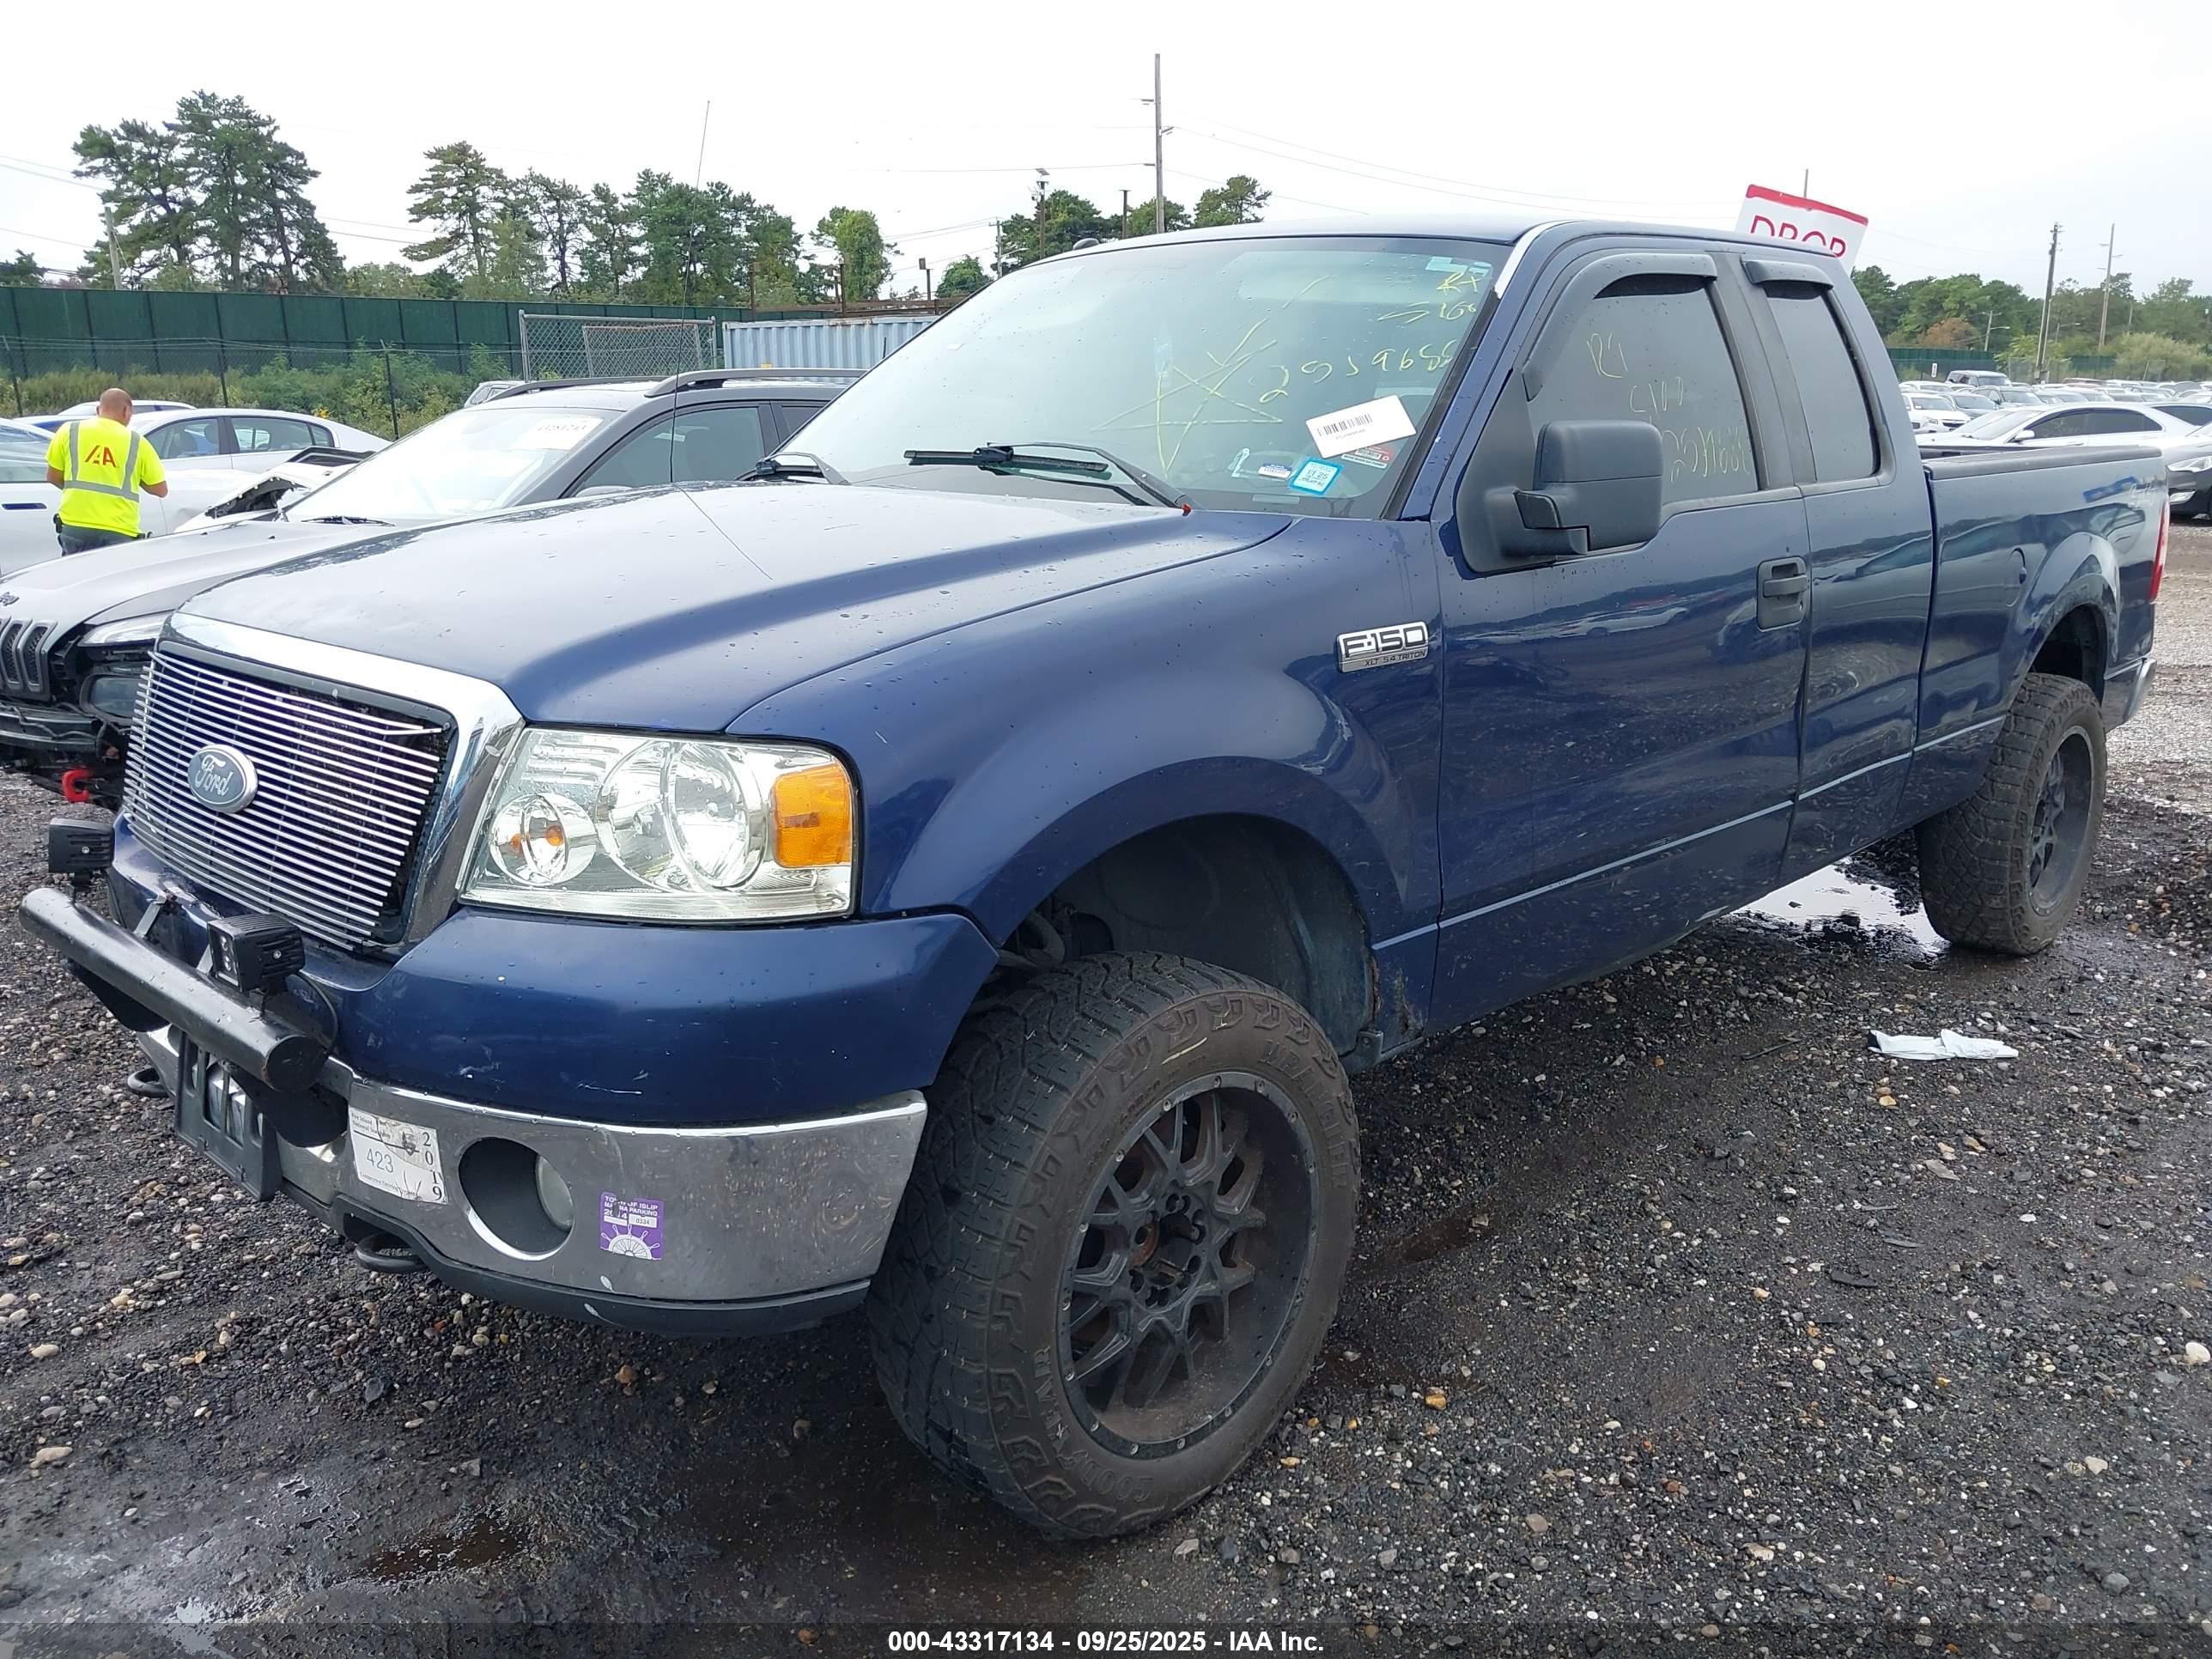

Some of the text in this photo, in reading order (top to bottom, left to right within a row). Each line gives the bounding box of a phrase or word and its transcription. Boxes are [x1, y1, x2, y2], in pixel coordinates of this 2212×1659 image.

[1364, 658, 1379, 667] XLT
[1397, 649, 1425, 660] TRITON
[195, 754, 234, 797] Ford
[367, 1148, 393, 1173] 423
[629, 1206, 659, 1217] PARKING
